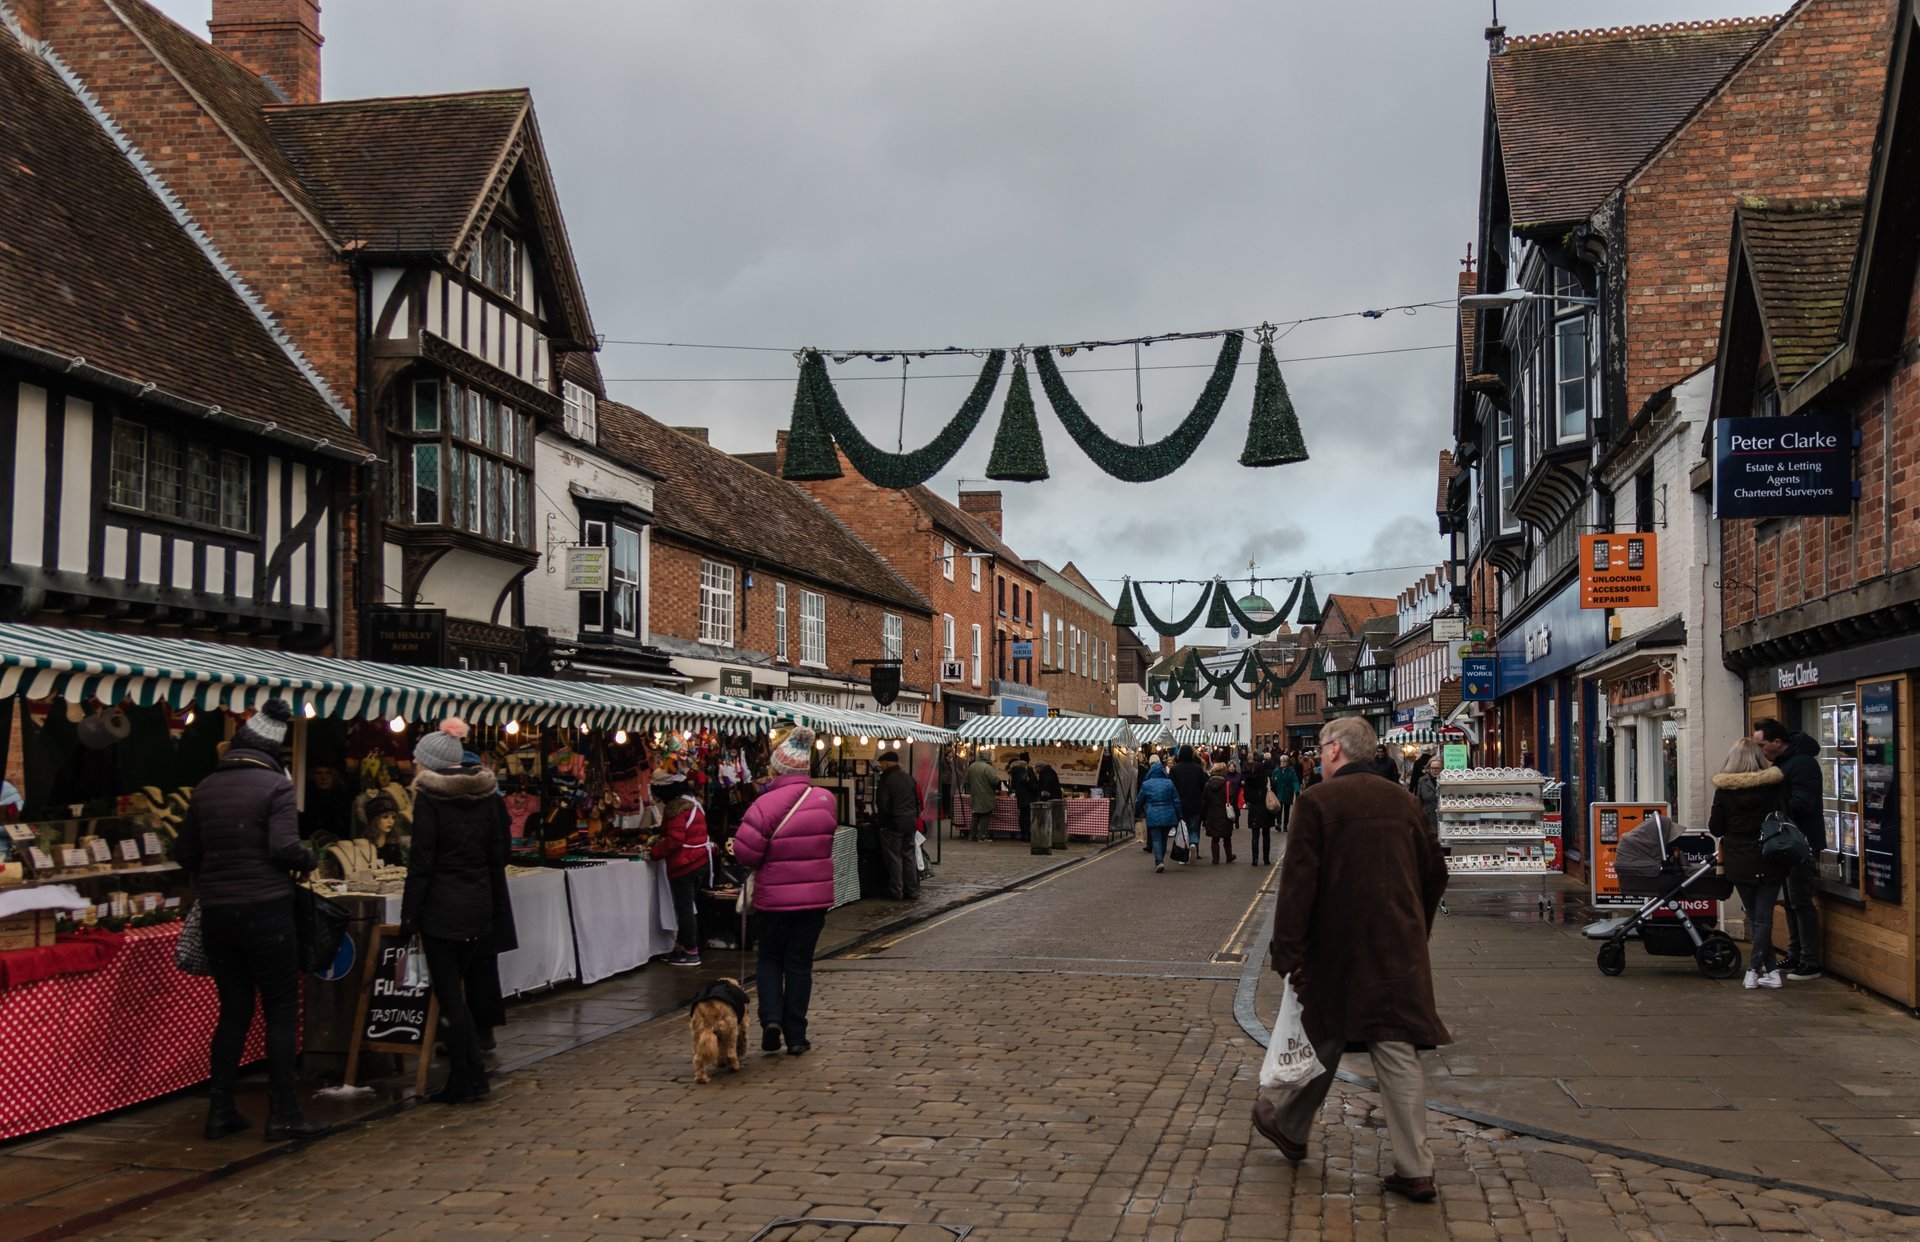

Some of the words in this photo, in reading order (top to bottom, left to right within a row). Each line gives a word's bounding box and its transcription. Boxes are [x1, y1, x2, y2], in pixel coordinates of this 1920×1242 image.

[1731, 435, 1775, 451] Peter
[1780, 431, 1837, 450] Clarke
[1746, 463, 1774, 473] Estate
[1777, 462, 1785, 472] &
[1788, 461, 1822, 473] Letting
[1766, 475, 1801, 487] Agents
[1734, 487, 1782, 499] Chartered
[1785, 487, 1834, 498] Surveyors
[572, 554, 600, 562] SUBWAY
[572, 565, 600, 573] SUBWAY
[571, 576, 599, 585] SUBWAY
[1593, 576, 1642, 584] UNLOCKING
[1593, 585, 1651, 594] ACCESSORIES
[1593, 596, 1630, 604] REPAIRS
[380, 631, 395, 640] THE
[398, 631, 433, 640] HENLEY
[392, 642, 419, 651] ROOM
[945, 663, 960, 677] M
[1778, 668, 1795, 689] Peter
[1796, 661, 1819, 686] Clarke
[731, 675, 743, 686] THE
[724, 686, 750, 699] SOUVENIR
[801, 690, 836, 706] WINTER
[897, 702, 919, 714] WINTER
[371, 1009, 424, 1025] TASTINGS
